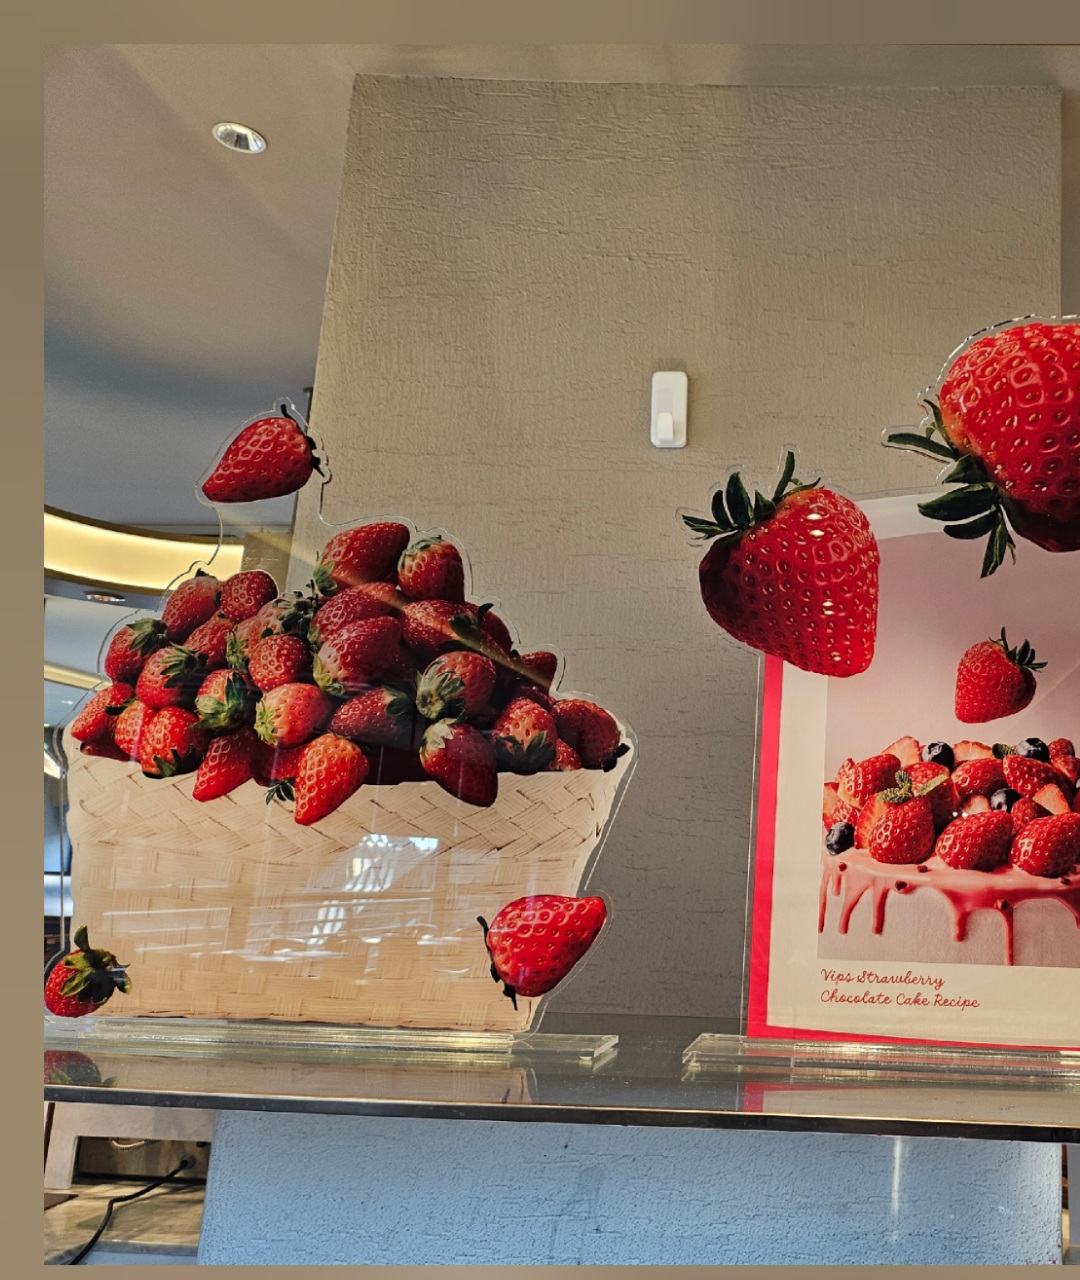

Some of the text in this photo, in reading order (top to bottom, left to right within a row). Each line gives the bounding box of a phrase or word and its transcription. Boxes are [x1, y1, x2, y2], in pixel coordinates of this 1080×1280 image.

[821, 968, 945, 990] Vips Strawberry
[820, 988, 980, 1011] Chocolate Cake Recipe
